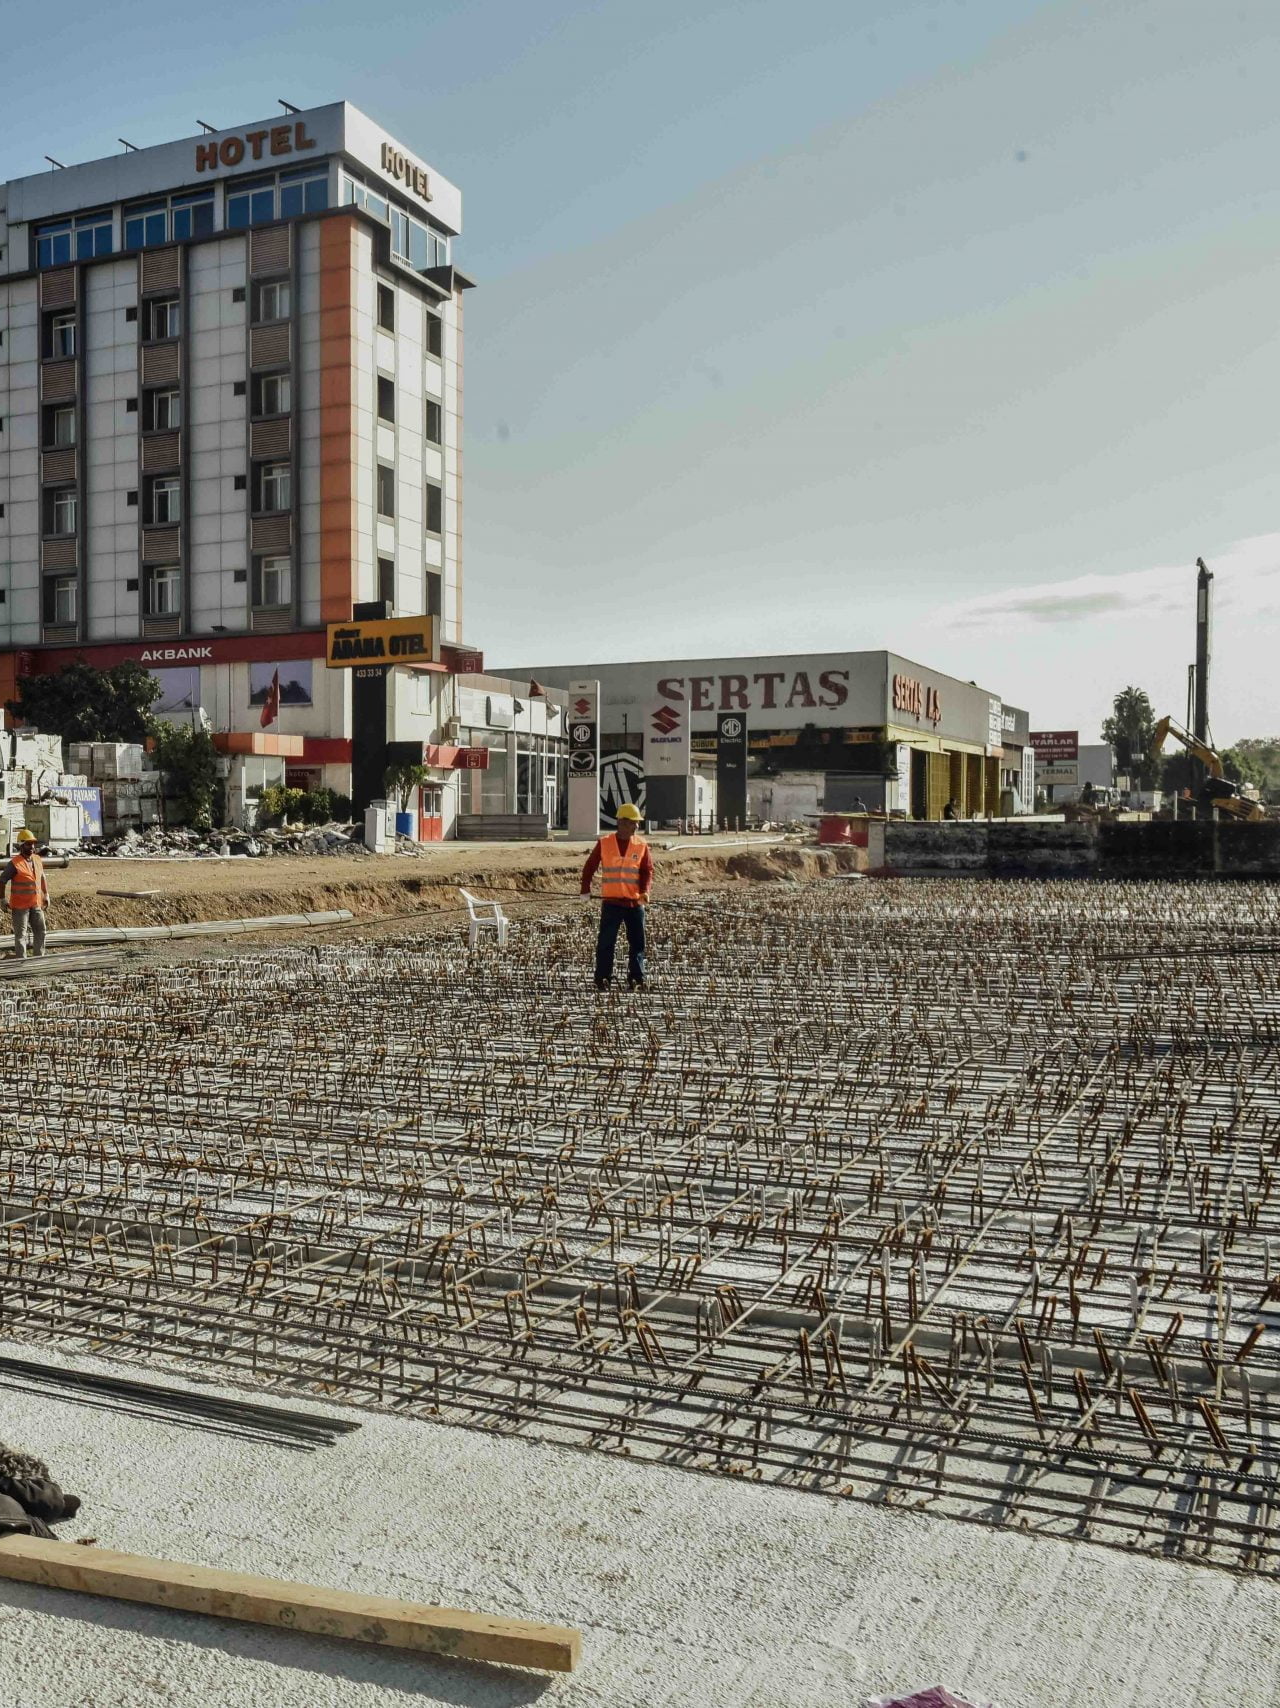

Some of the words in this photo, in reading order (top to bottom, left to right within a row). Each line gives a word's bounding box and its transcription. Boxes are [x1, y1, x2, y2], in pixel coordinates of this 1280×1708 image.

[195, 122, 316, 172] HOTEL
[381, 141, 433, 203] HOTEL
[141, 647, 213, 661] AKBANK
[331, 636, 386, 660] ADANA
[389, 634, 428, 656] OTEL
[356, 669, 366, 678] 433
[656, 670, 850, 711] SERTAŞ
[893, 674, 923, 721] SERTAŞ
[723, 719, 740, 736] MG
[73, 789, 97, 801] FAYANS
